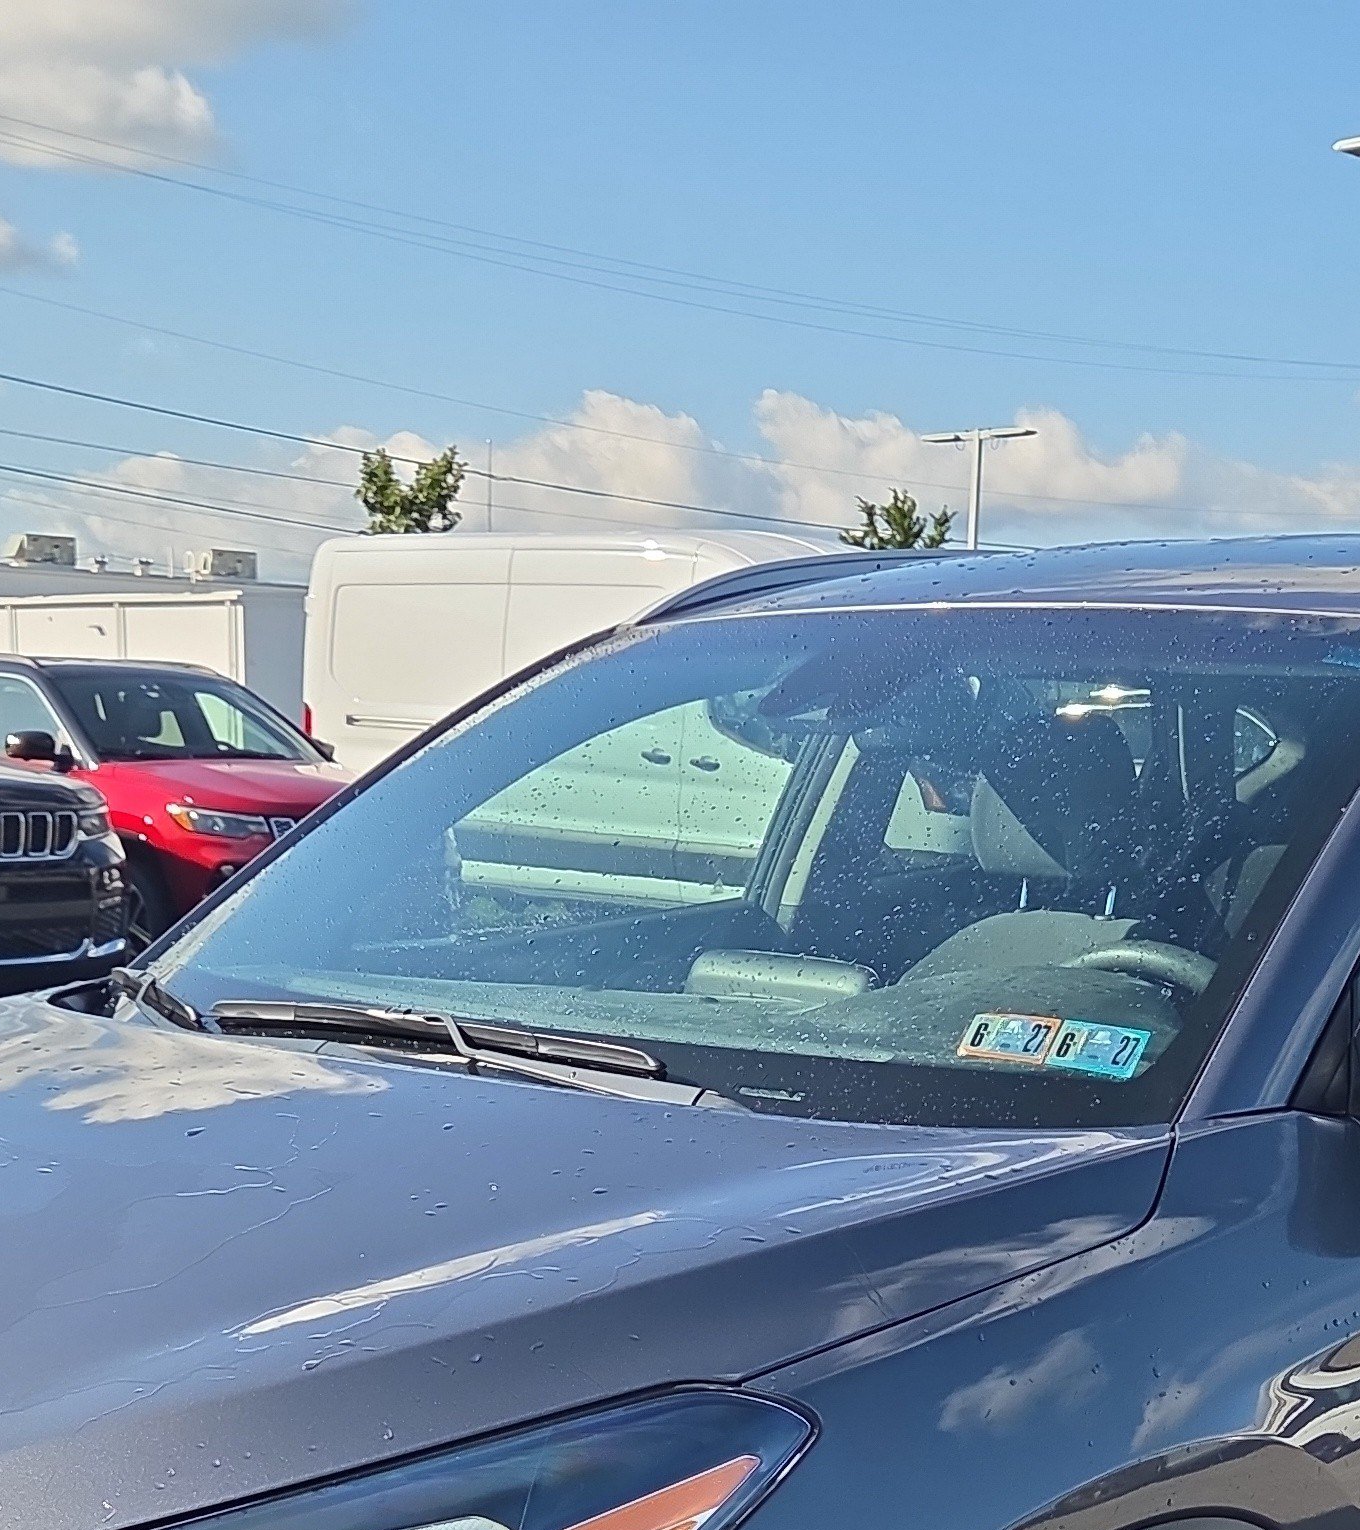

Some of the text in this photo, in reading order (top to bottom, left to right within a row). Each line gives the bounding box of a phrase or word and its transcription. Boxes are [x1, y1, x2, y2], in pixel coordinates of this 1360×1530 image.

[970, 1022, 1052, 1053] 6 27
[1055, 1032, 1141, 1066] 6 27
